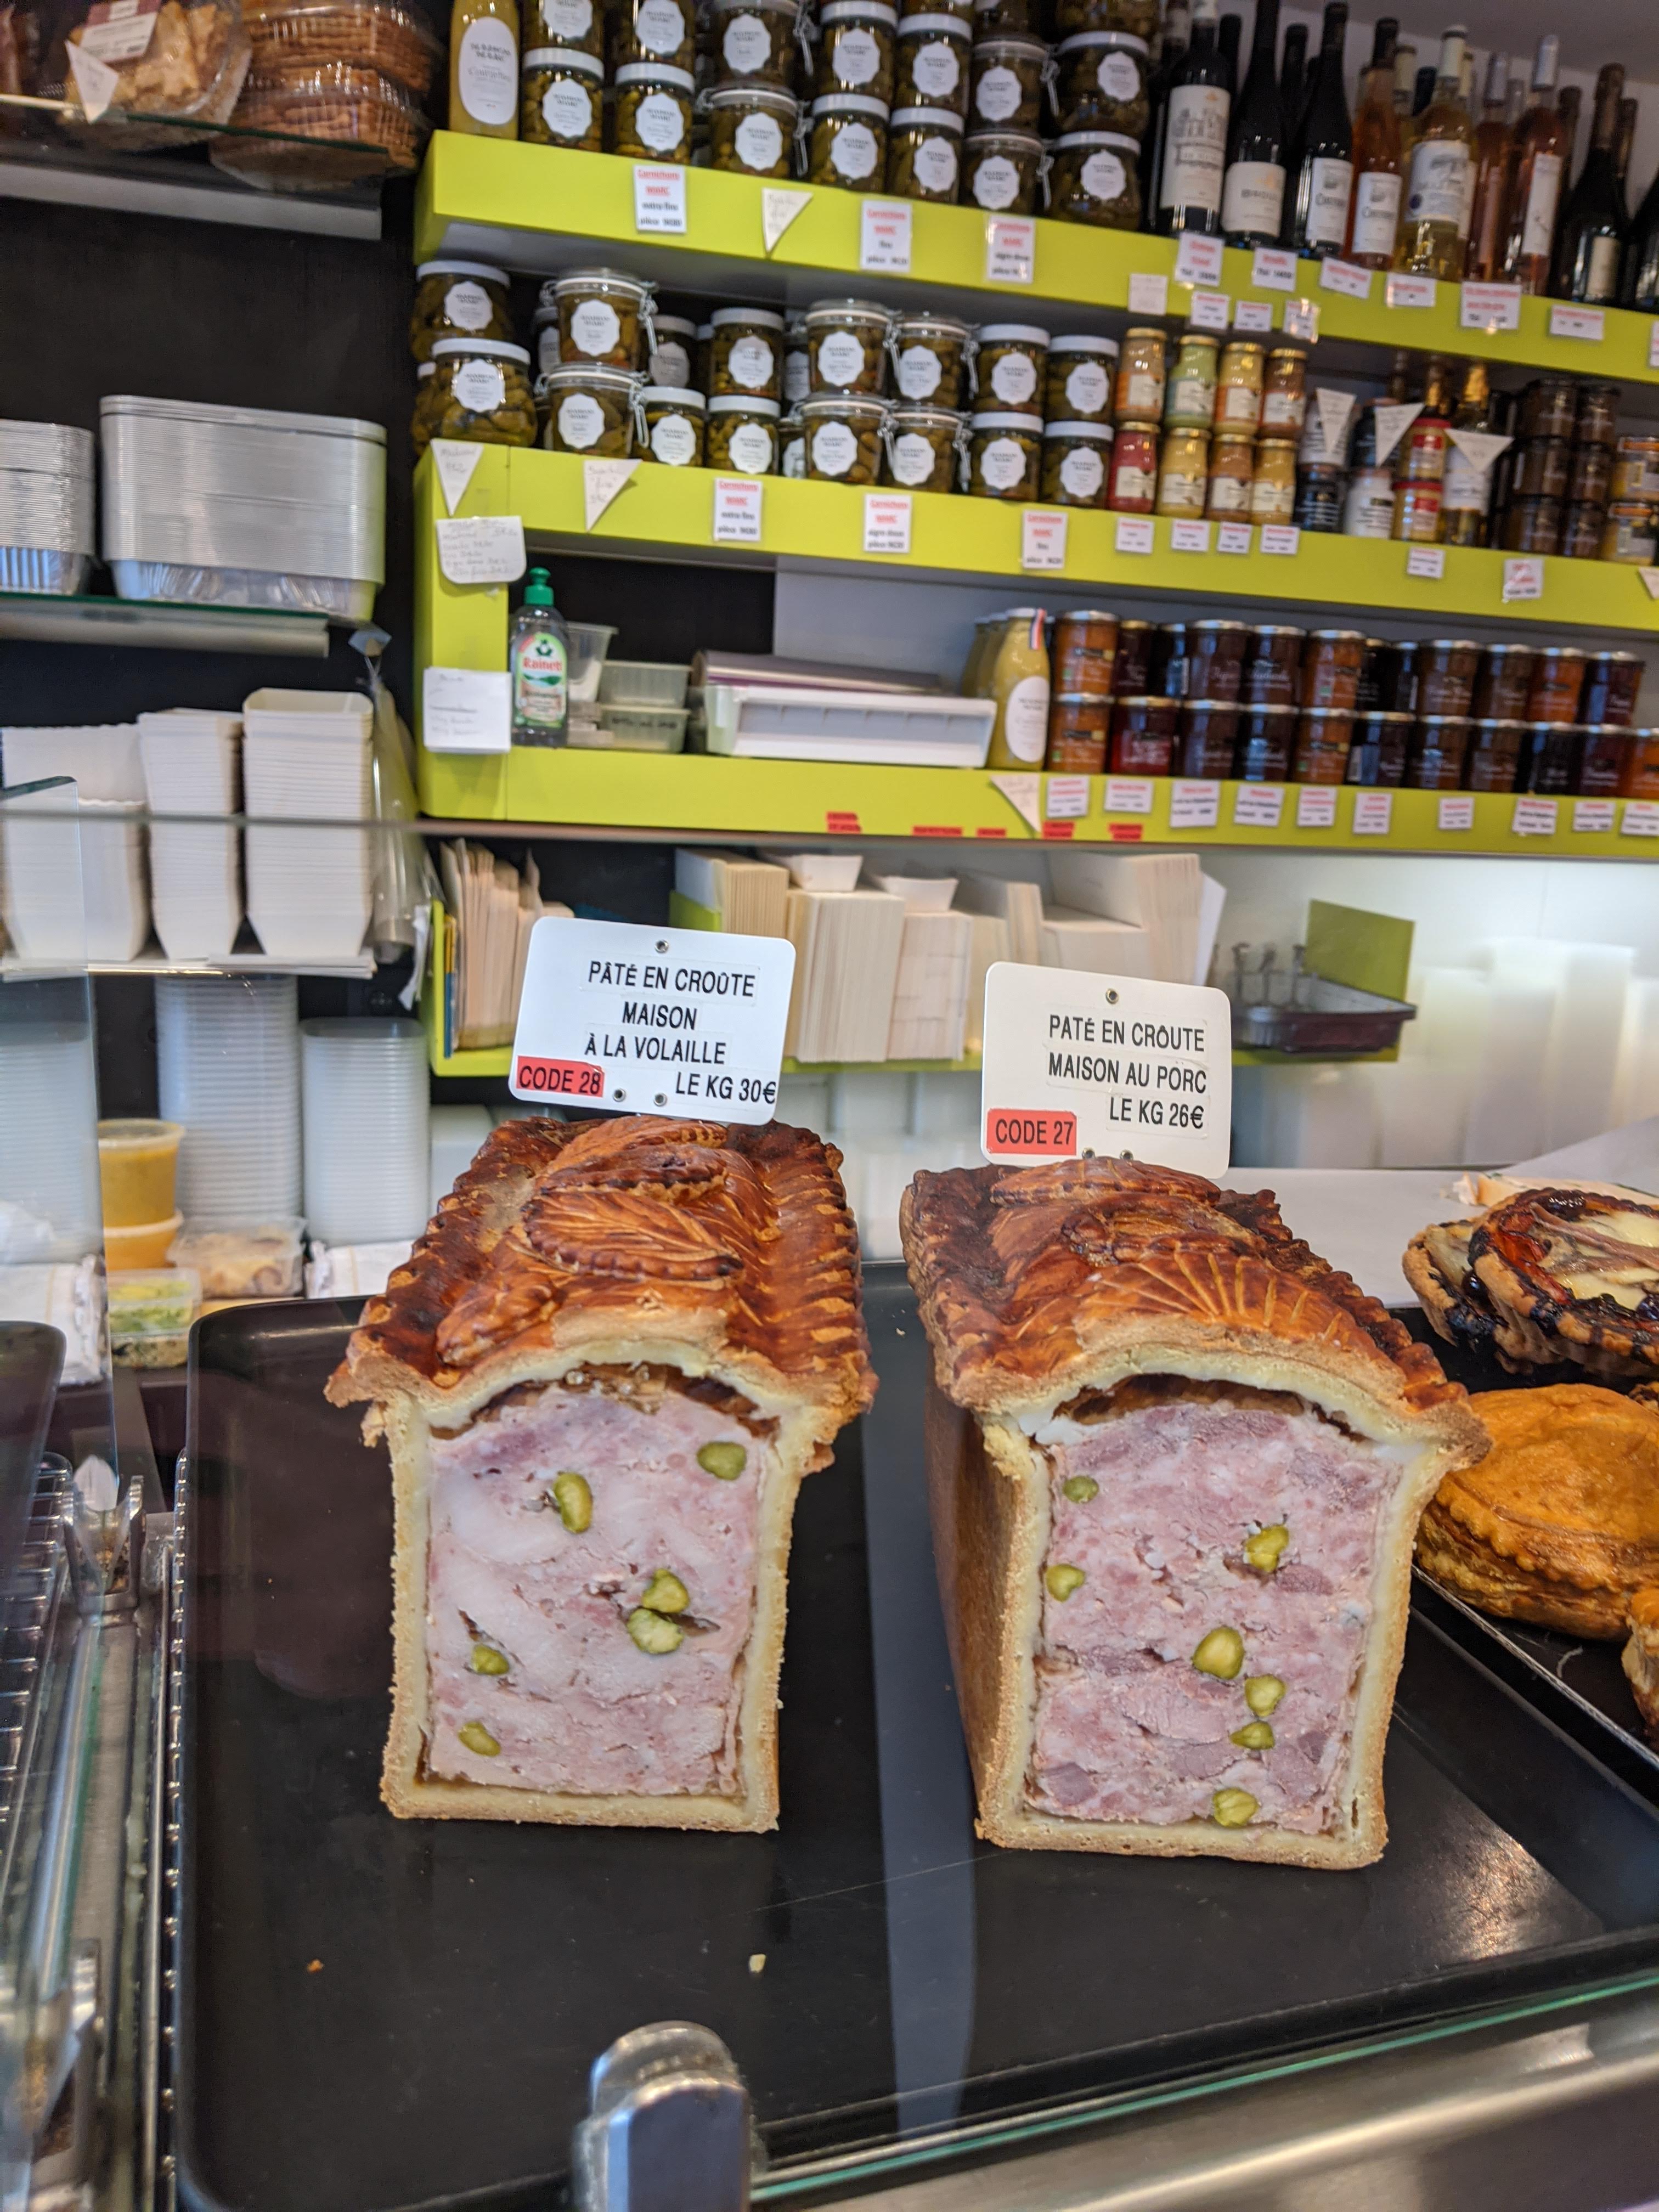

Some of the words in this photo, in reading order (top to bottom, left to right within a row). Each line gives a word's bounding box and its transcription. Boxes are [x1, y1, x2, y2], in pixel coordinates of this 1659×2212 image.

[588, 960, 637, 986] PÂTÉ
[644, 966, 669, 989] EN
[674, 969, 756, 997] CROÛTE
[622, 1001, 697, 1030] MAISON
[1049, 1014, 1095, 1042] PATÉ
[1102, 1020, 1125, 1045] EN
[584, 1033, 597, 1056] À
[603, 1036, 627, 1058] LA
[635, 1037, 727, 1064] VOLAILLE
[519, 1066, 574, 1093] CODE
[578, 1070, 601, 1095] 28
[675, 1071, 701, 1095] LE
[706, 1075, 733, 1100] KG
[738, 1079, 777, 1104] 30€
[1048, 1052, 1119, 1084] MAISON
[1125, 1062, 1150, 1087] AU
[1156, 1066, 1207, 1094] PORC
[1109, 1097, 1132, 1122] LE
[1139, 1099, 1164, 1125] KG
[1169, 1102, 1205, 1130] 26€
[995, 1118, 1047, 1145] CODE
[1053, 1120, 1074, 1146] 27
